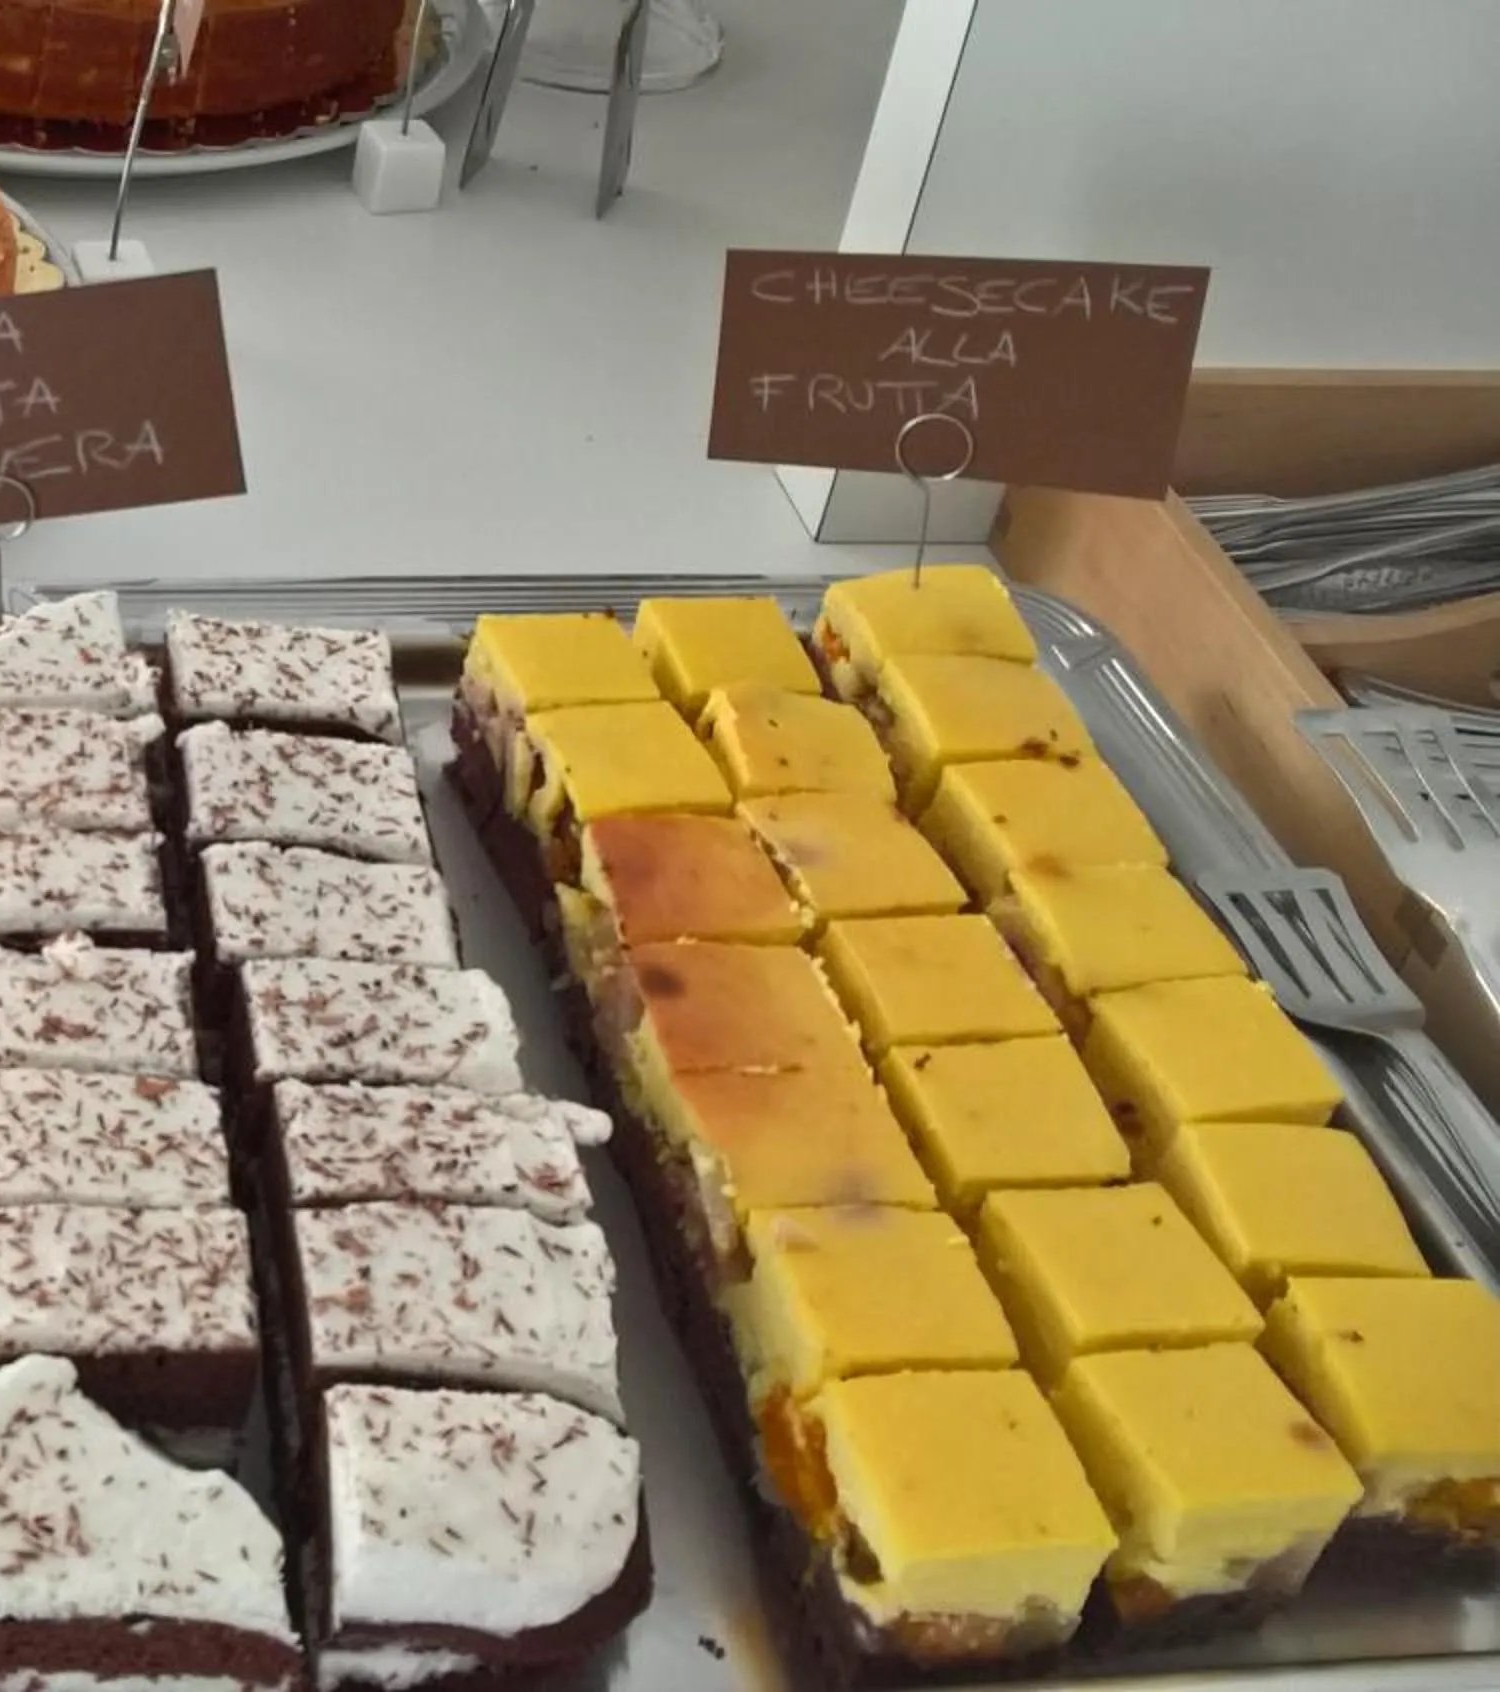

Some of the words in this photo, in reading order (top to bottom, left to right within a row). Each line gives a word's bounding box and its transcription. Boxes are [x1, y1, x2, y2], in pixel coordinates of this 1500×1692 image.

[751, 268, 1194, 323] CHEESECAKE
[878, 327, 1018, 367] ALLA
[750, 374, 979, 420] FRUTTA
